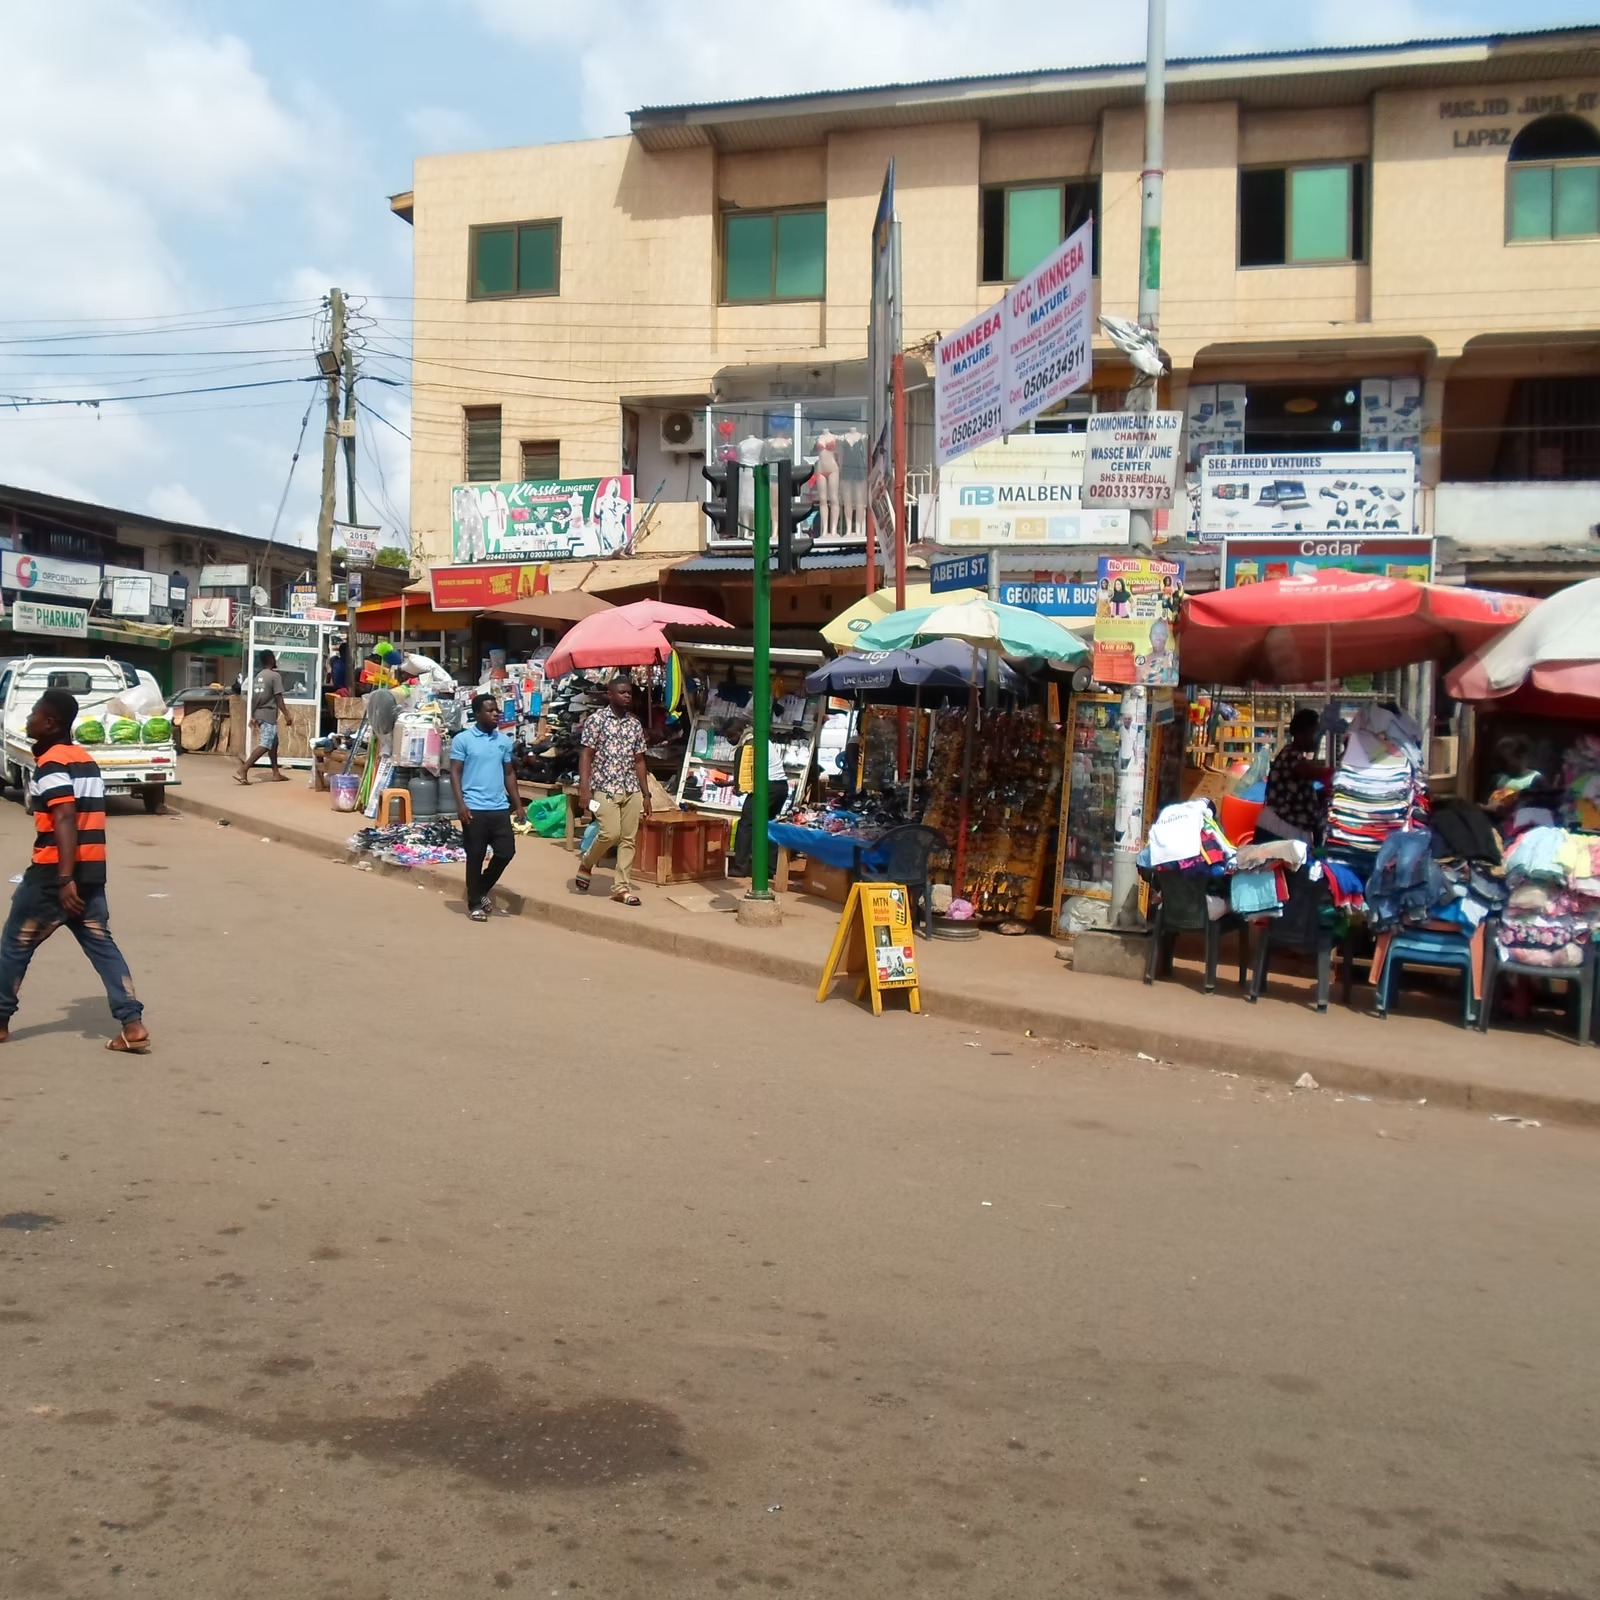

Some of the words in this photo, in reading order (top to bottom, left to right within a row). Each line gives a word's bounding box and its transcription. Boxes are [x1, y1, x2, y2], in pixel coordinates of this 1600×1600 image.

[1440, 98, 1509, 119] MASJID
[1454, 128, 1512, 148] LAPAZ
[1010, 327, 1043, 355] ENTRANCE
[1043, 316, 1064, 336] EXAMS
[1064, 289, 1087, 324] CLASSES
[941, 313, 1001, 365] WINNEBA
[1019, 357, 1047, 379] DISTANCE
[1051, 334, 1078, 358] REGULAR
[1023, 341, 1085, 400] 0506234911
[951, 404, 1002, 445] 0506234911
[1090, 416, 1154, 432] COMMONWEALTH
[1156, 415, 1178, 430] S.H.S
[1114, 432, 1157, 443] CHANTAN
[1071, 450, 1085, 459] MT
[1091, 447, 1124, 460] WASSCE
[1111, 462, 1152, 472] CENTER
[1208, 458, 1268, 469] SEG-AFREDO
[1270, 456, 1322, 468] VENTURES
[1100, 473, 1117, 483] SHS
[1118, 474, 1124, 483] &
[1125, 473, 1168, 484] REMEDIAL
[508, 482, 561, 505] Klassic
[998, 485, 1072, 501] MALBEN
[1089, 485, 1171, 500] 0203337373
[350, 532, 368, 540] 2015
[485, 552, 524, 561] 0244210676
[529, 550, 570, 558] 0203361050
[1299, 540, 1360, 556] Cedar
[933, 560, 969, 582] ABETEI
[971, 557, 987, 576] ST.
[1109, 560, 1122, 571] No
[1122, 561, 1141, 571] Pills
[1149, 562, 1162, 572] No
[1162, 562, 1180, 574] Diet
[42, 571, 88, 586] OPPORTUNITY
[1006, 587, 1054, 604] GEORGE
[1056, 587, 1071, 604] W.
[1072, 587, 1097, 604] BUS
[36, 608, 85, 629] PHARMACY
[193, 618, 226, 627] MoneyGram
[850, 619, 870, 631] MTN
[843, 675, 856, 685] Live
[864, 674, 879, 684] Love
[872, 897, 889, 907] MTN
[874, 914, 890, 923] Money
